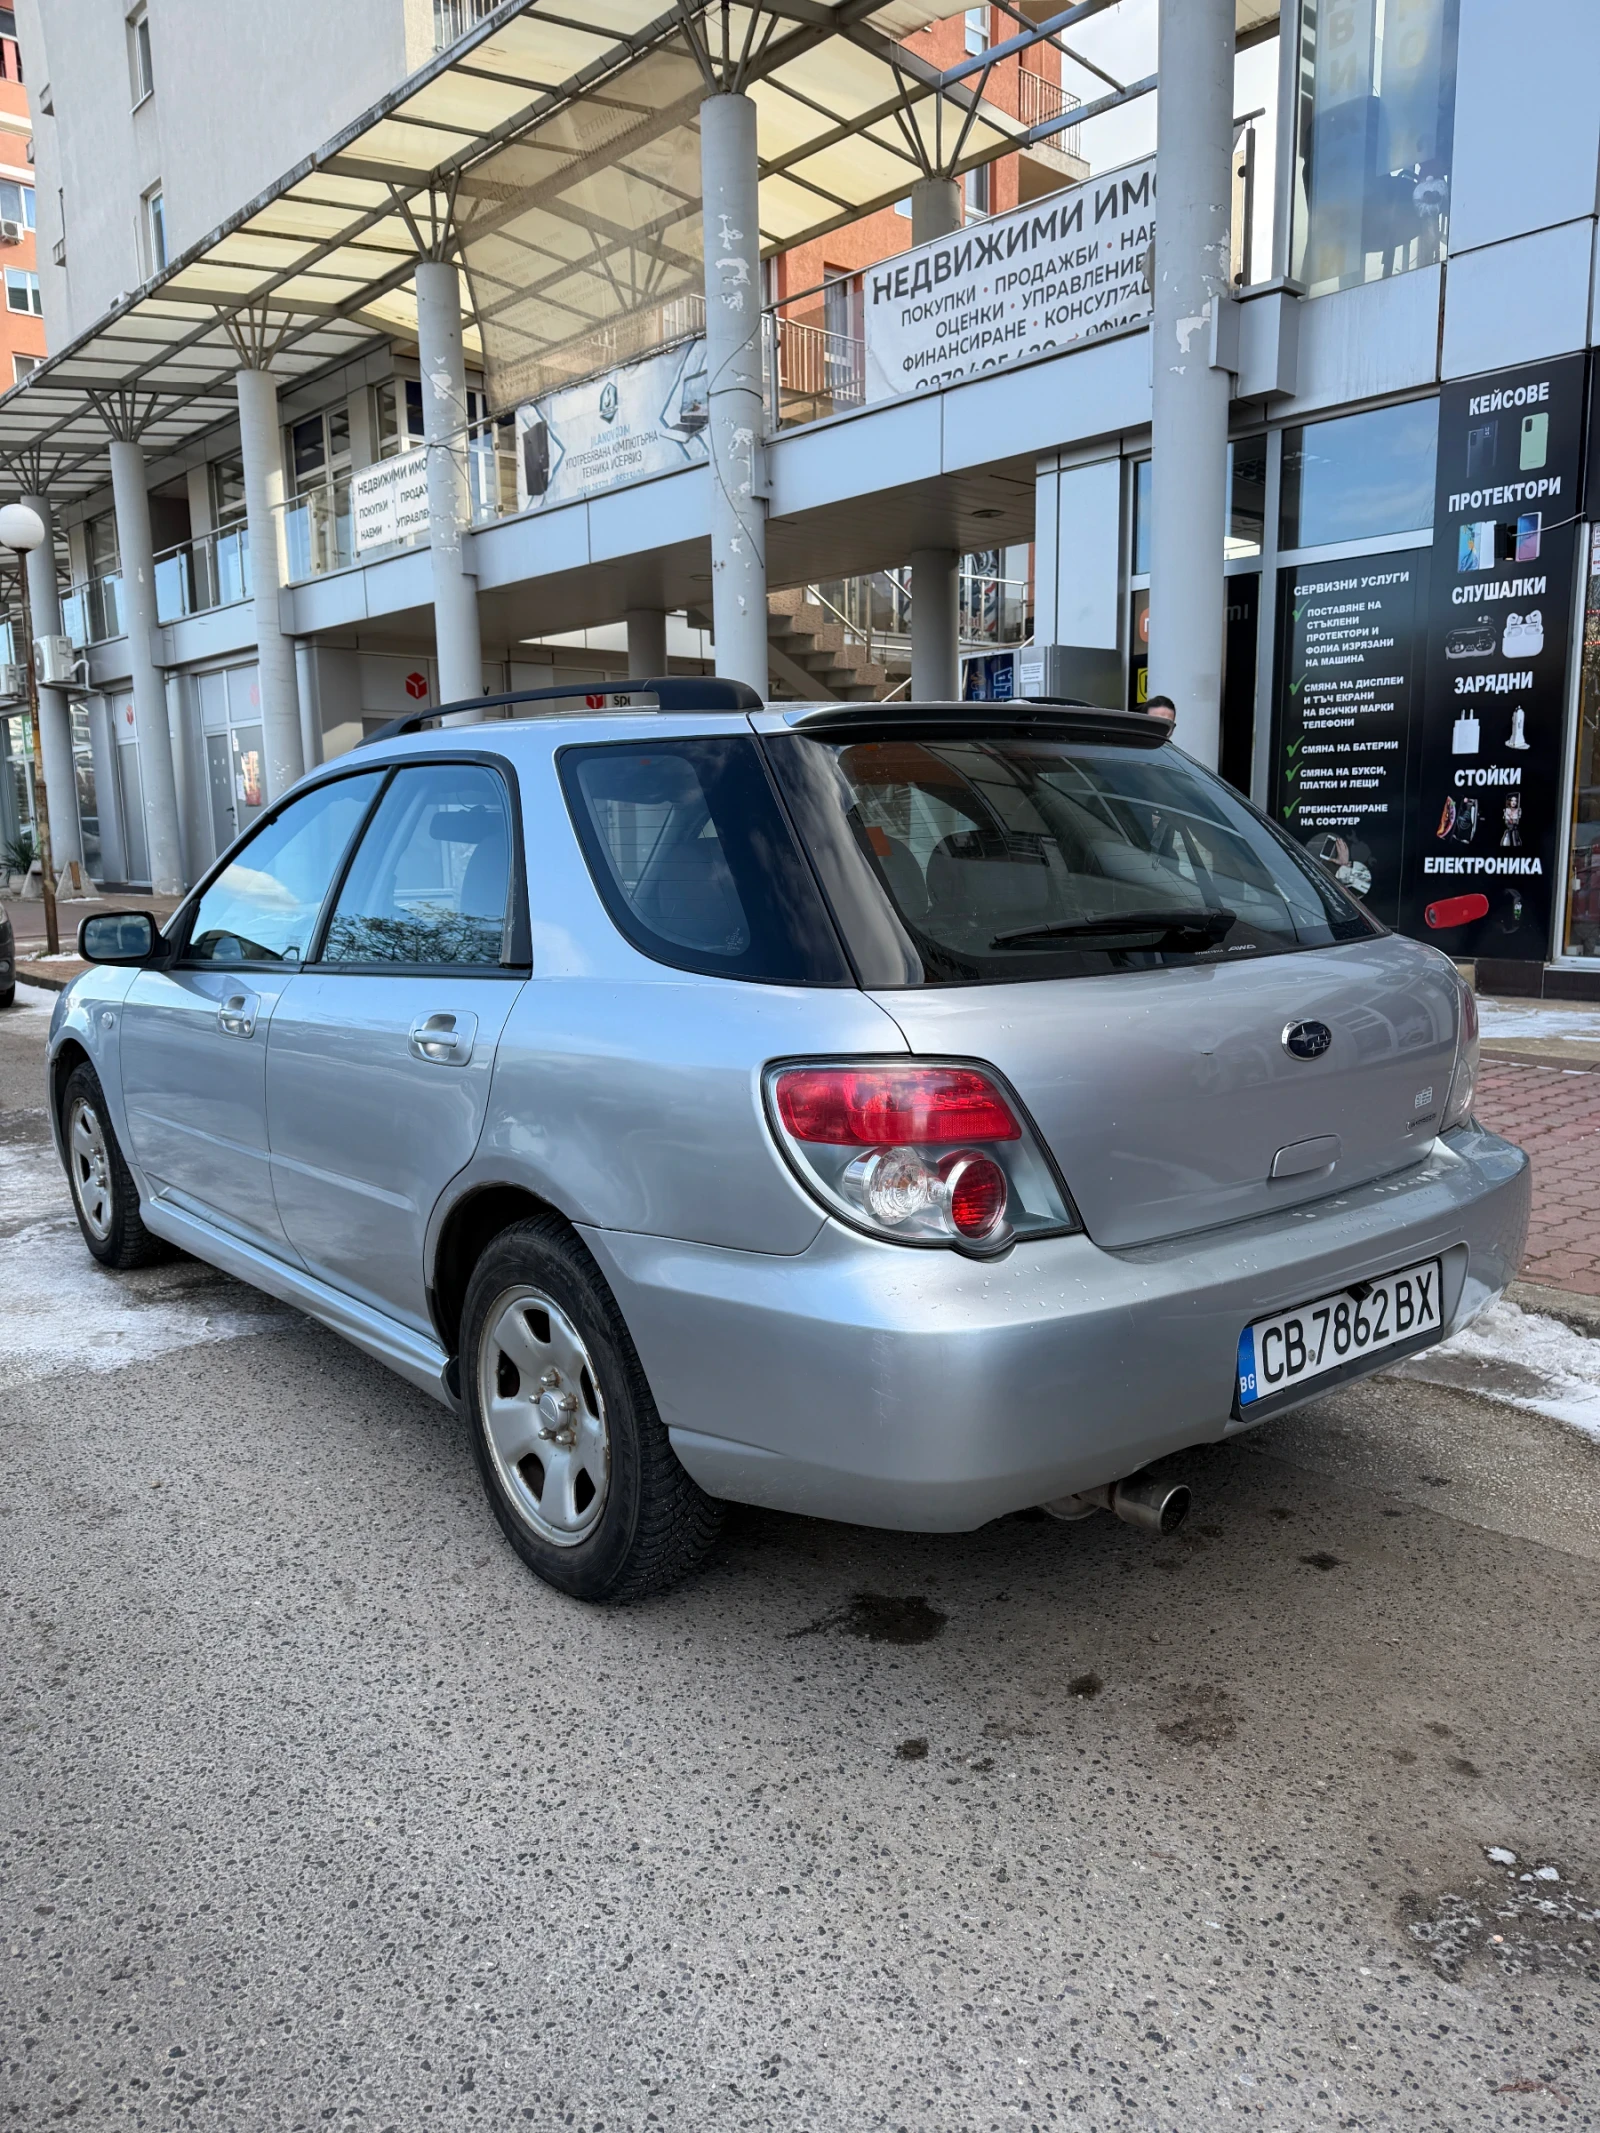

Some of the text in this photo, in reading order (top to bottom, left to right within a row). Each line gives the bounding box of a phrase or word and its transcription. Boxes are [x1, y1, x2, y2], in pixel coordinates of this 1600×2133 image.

[873, 171, 1156, 305] НЕДВИЖИМИ ИМ
[902, 285, 976, 327] ПОКУПКИ
[995, 241, 1098, 295] ПРОДАЖБИ
[936, 252, 1145, 338] ОЦЕНКИ УПРАВЛЕНИЕ
[902, 319, 1026, 372] ФИНАНСИРАНЕ
[1469, 382, 1549, 416] КЕЙСОВЕ
[358, 465, 407, 496] НЕДВИЖИМИ
[1448, 476, 1561, 512] ПРОТЕКТОРИ
[359, 499, 388, 519] ПОКУПКИ
[361, 525, 382, 540] НАЕМИ
[1294, 571, 1410, 596] СЕРВИЗНИ УСЛУГИ
[1452, 576, 1546, 605] СЛУШАЛКИ
[1307, 601, 1381, 617] ПОСТАВЯНЕ НА
[1306, 616, 1359, 630] СТЪКЛЕНИ
[1306, 627, 1379, 642] ПРОТЕКТОРИ И
[1305, 638, 1394, 655] ФОЛИА ИЗРЯЗАНИ
[1305, 654, 1364, 667] НА МАШИНА
[1304, 676, 1404, 692] СМЯНА НА ДИСПЛЕИ
[1454, 671, 1533, 694] ЗАРЯДНИ
[1303, 691, 1374, 705] И ТЪЧ ЕКРАНИ
[1303, 702, 1394, 717] НА ВСИЧКИ МАРКИ
[1302, 718, 1355, 729] ТЕЛЕФОНИ
[1301, 741, 1399, 754] СМЯНА НА БАТЕРИИ
[1300, 766, 1387, 777] СМЯНА НА БУКСИ,
[1454, 765, 1522, 787] СТОЙКИ
[1300, 779, 1379, 790] ПЛАТКИ И ЛЕЩИ
[1299, 804, 1388, 814] ПРЕИНСТАЛИРАНЕ
[1300, 817, 1360, 826] НА СОФТУЕР
[1424, 856, 1542, 875] ЕЛЕКТРОНИКА
[1228, 944, 1256, 952] AWD
[1312, 1288, 1389, 1366] 7862
[1240, 1373, 1255, 1393] BG
